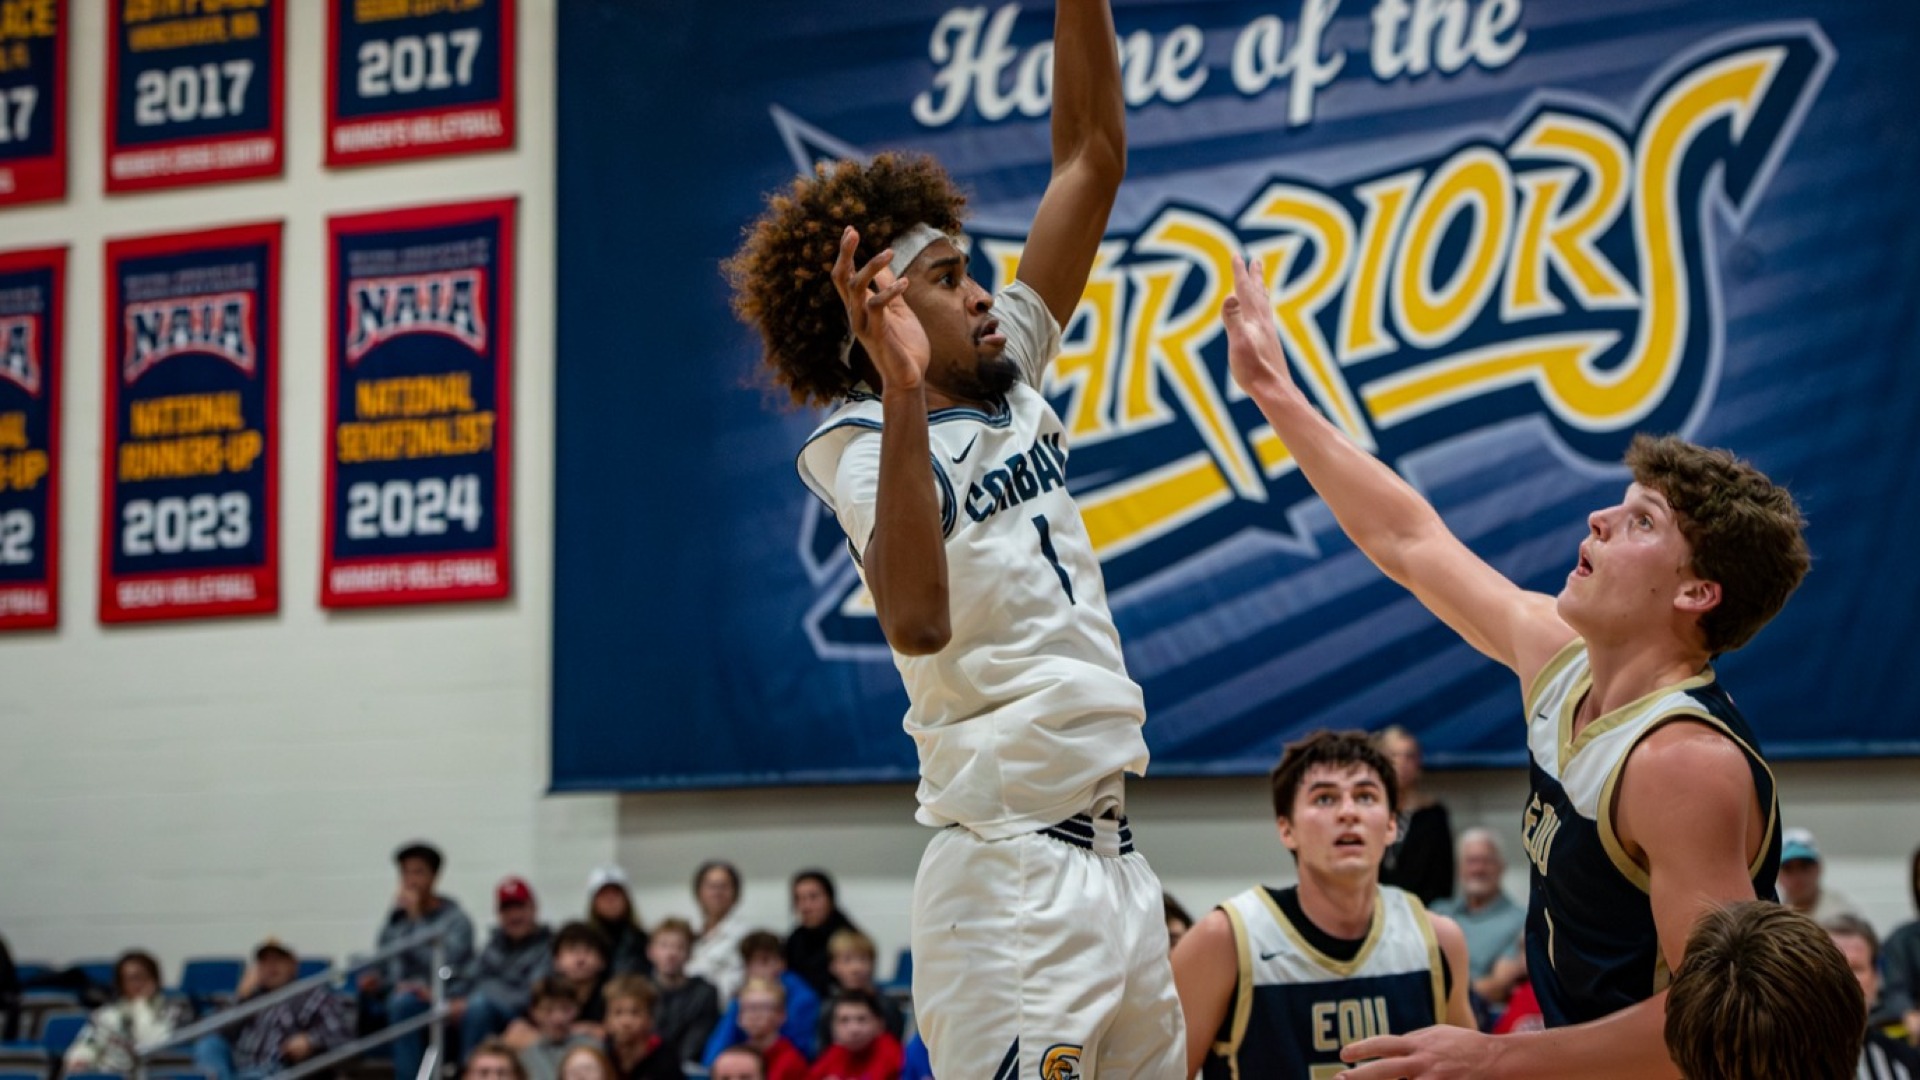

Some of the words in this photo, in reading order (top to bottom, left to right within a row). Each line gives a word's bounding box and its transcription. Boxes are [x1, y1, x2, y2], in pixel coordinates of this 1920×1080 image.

[135, 59, 254, 126] 2017
[357, 27, 482, 98] 2017
[912, 4, 1207, 127] Hoe
[1232, 0, 1345, 127] of
[1371, 0, 1527, 79] the
[127, 297, 255, 377] NAIA
[349, 272, 485, 357] NAIA
[131, 390, 246, 438] NATIONAL
[355, 370, 477, 419] NATIONAL
[119, 429, 263, 481] RUNNERS-UP
[337, 410, 497, 464] SEMIFINALIST
[122, 490, 252, 557] 2023
[347, 473, 483, 539] 2024
[1031, 513, 1076, 606] 1
